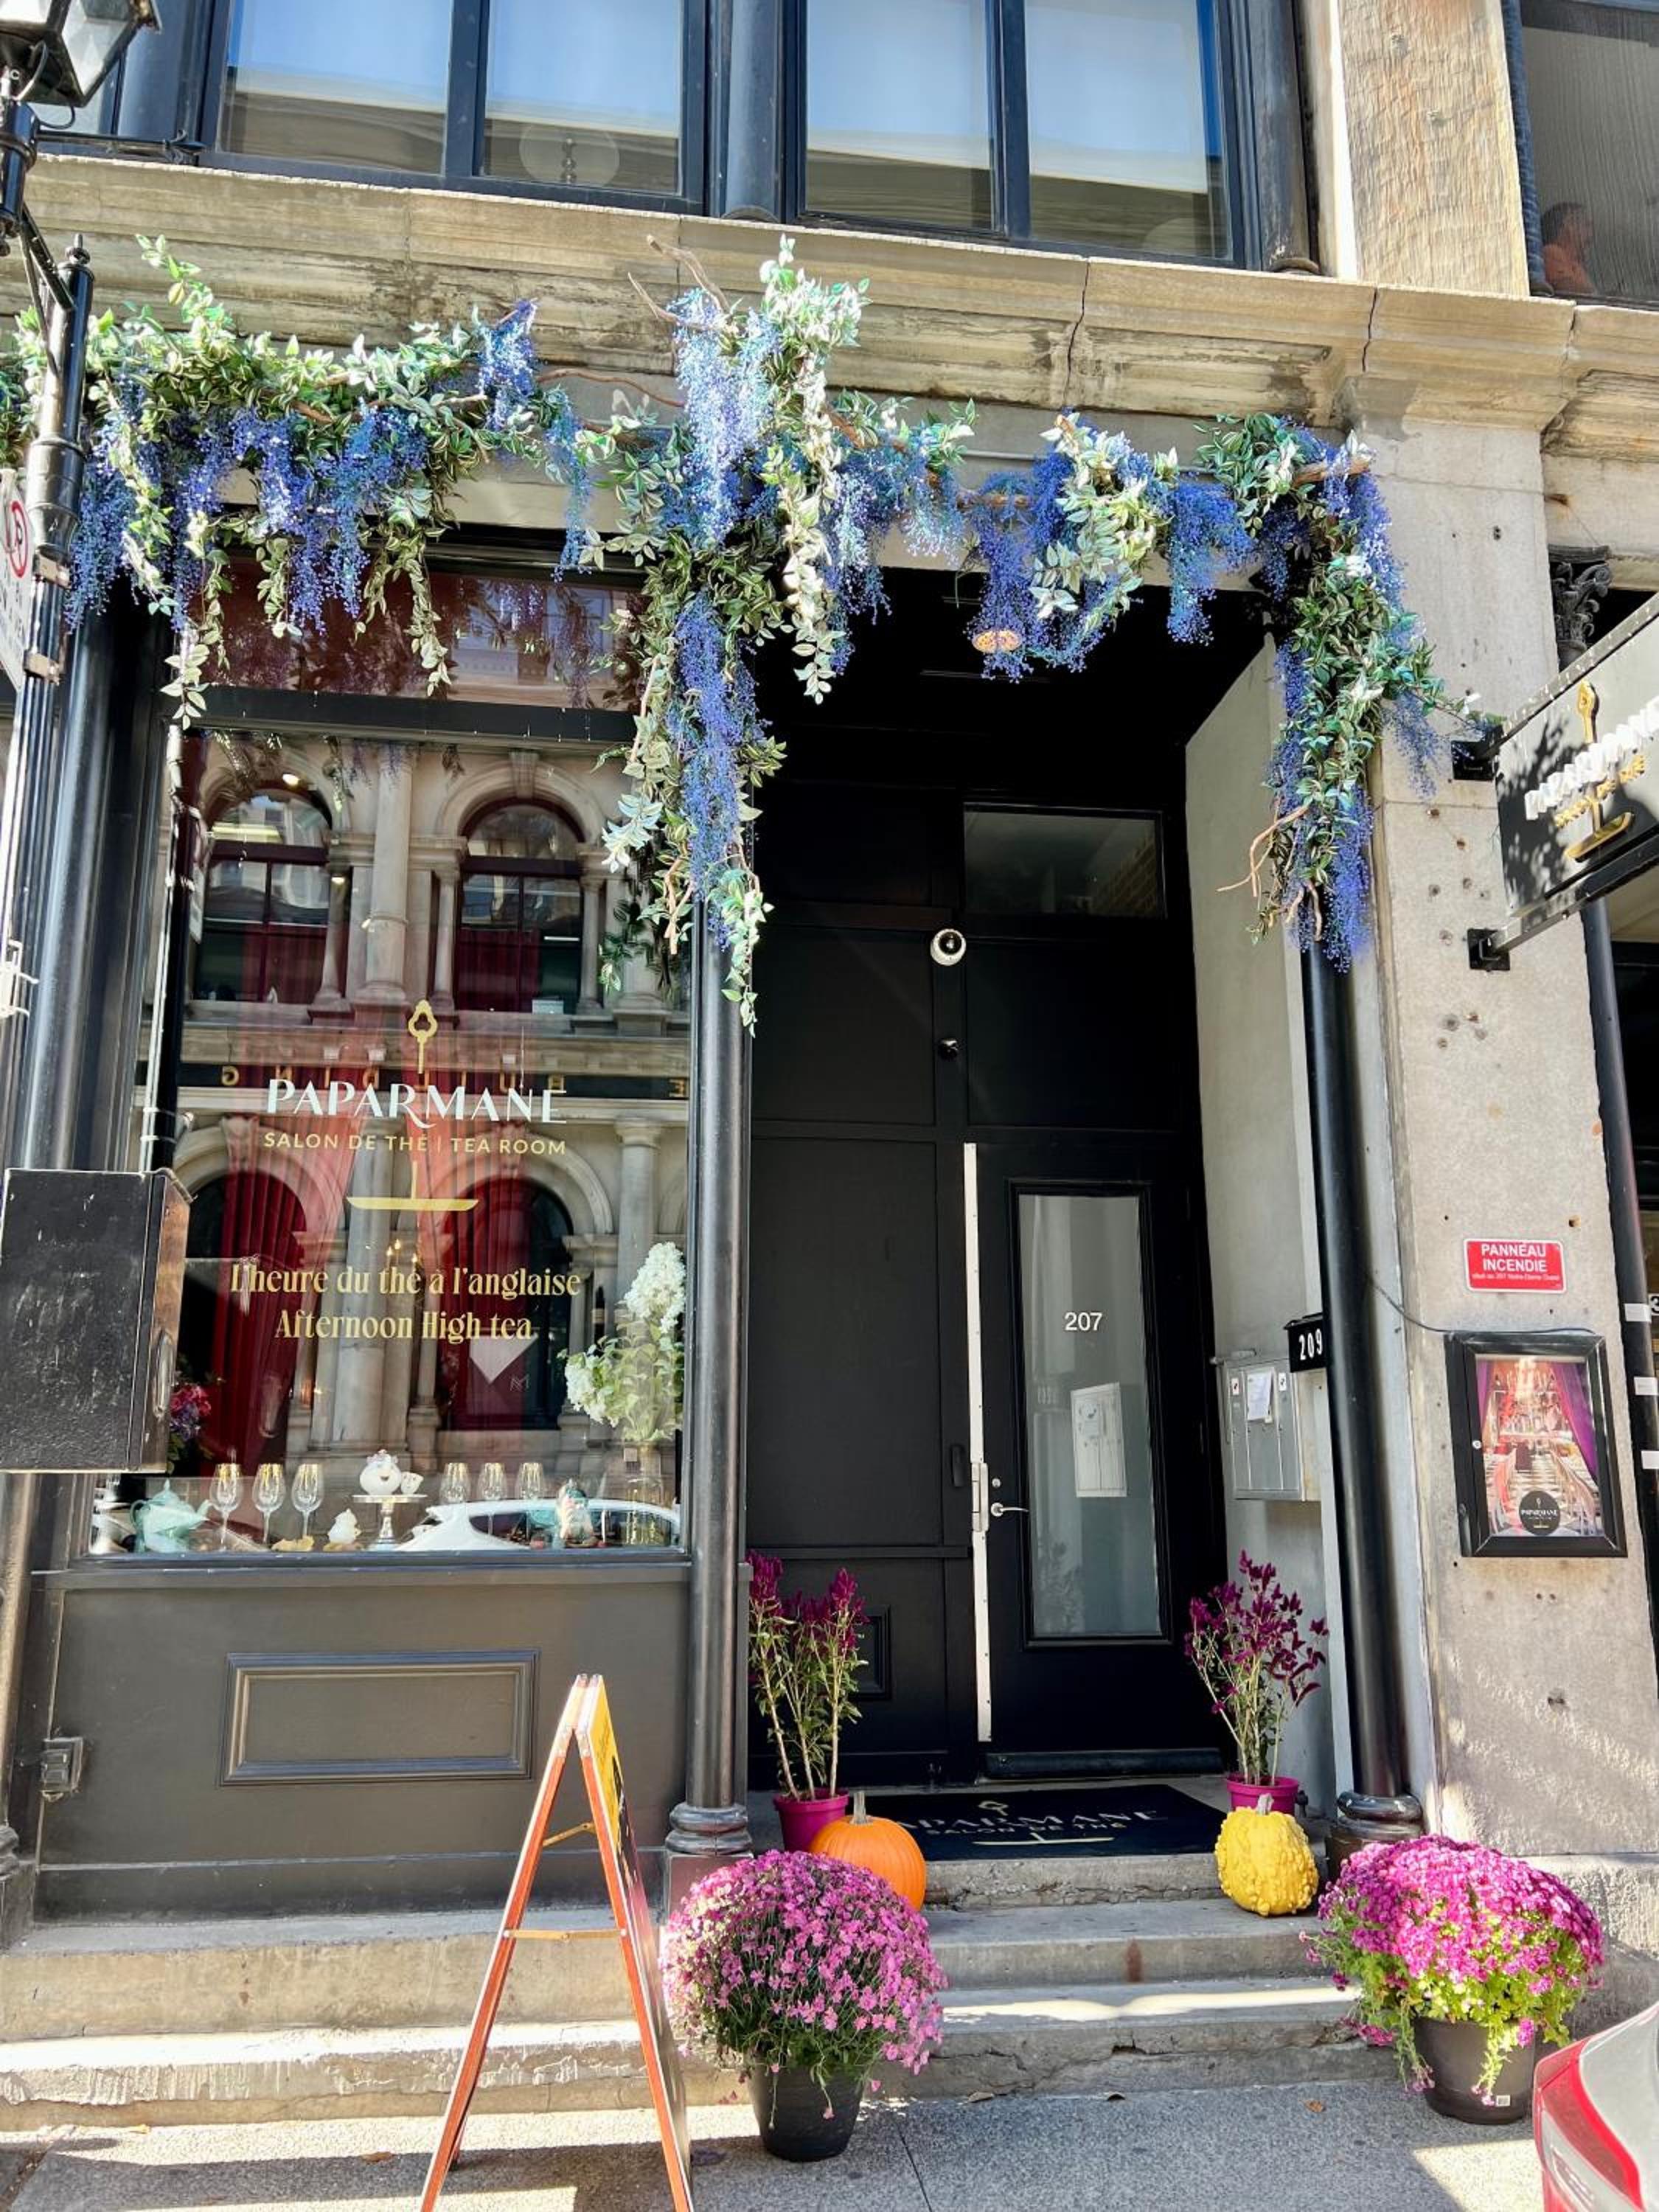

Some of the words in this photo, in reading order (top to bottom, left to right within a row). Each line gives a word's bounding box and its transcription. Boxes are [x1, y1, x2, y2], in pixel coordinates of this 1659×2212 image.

[267, 1079, 567, 1129] PAPARMANE
[263, 1132, 338, 1149] SALON
[349, 1135, 376, 1150] DE
[386, 1134, 428, 1151] THÉ
[451, 1138, 490, 1153] TEA
[499, 1139, 566, 1155] ROOM
[1483, 1258, 1547, 1272] INCENDIE
[337, 1266, 371, 1294] du
[453, 1267, 580, 1301] l'anglaise
[275, 1309, 412, 1339] Afternoon
[422, 1311, 481, 1344] High
[490, 1313, 532, 1340] tea
[1064, 1312, 1102, 1332] 207
[1298, 1328, 1323, 1360] 209
[897, 1810, 1168, 1829] APARMANE
